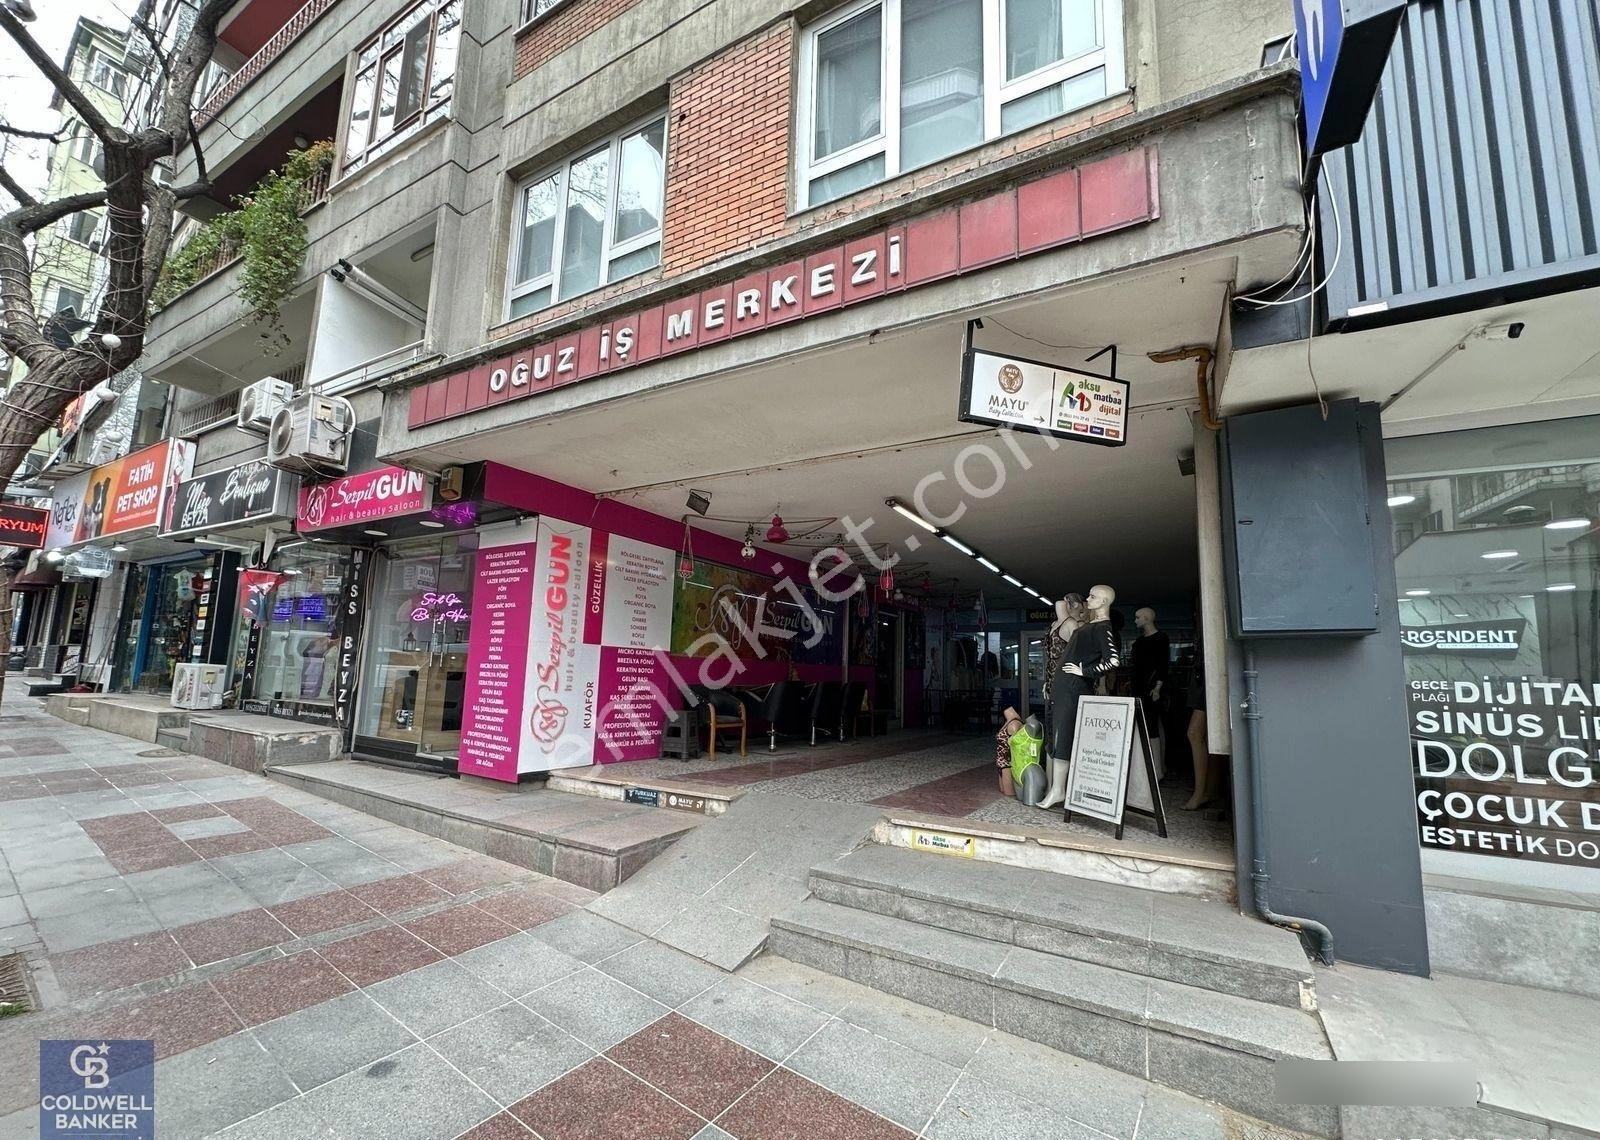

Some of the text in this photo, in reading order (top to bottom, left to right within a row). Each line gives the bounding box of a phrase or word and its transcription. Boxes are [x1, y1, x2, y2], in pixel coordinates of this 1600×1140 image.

[489, 234, 901, 393] OĞUZ İŞ MERKEZİ
[1078, 379, 1101, 392] aksu
[1093, 393, 1122, 405] matbaa
[1098, 404, 1121, 416] dijital
[127, 460, 155, 486] FATİH
[52, 496, 78, 529] Reflex
[116, 484, 158, 514] PET SHOP
[330, 500, 420, 523] hair & beauty saloon
[181, 507, 209, 529] BEYZA
[569, 592, 579, 644] beauty
[574, 542, 584, 590] saloon
[591, 560, 604, 614] GÜZELLİK
[336, 636, 354, 721] BEYZA
[1411, 680, 1449, 690] GECE
[583, 681, 594, 729] KUAFÖR
[1412, 691, 1450, 703] PLAĞI
[1084, 717, 1122, 731] FATOŞÇA
[1415, 705, 1544, 738] SİNÜS
[1417, 740, 1600, 788] DOLG
[1417, 789, 1569, 829] ÇOCUK
[1422, 825, 1549, 855] ESTETİK
